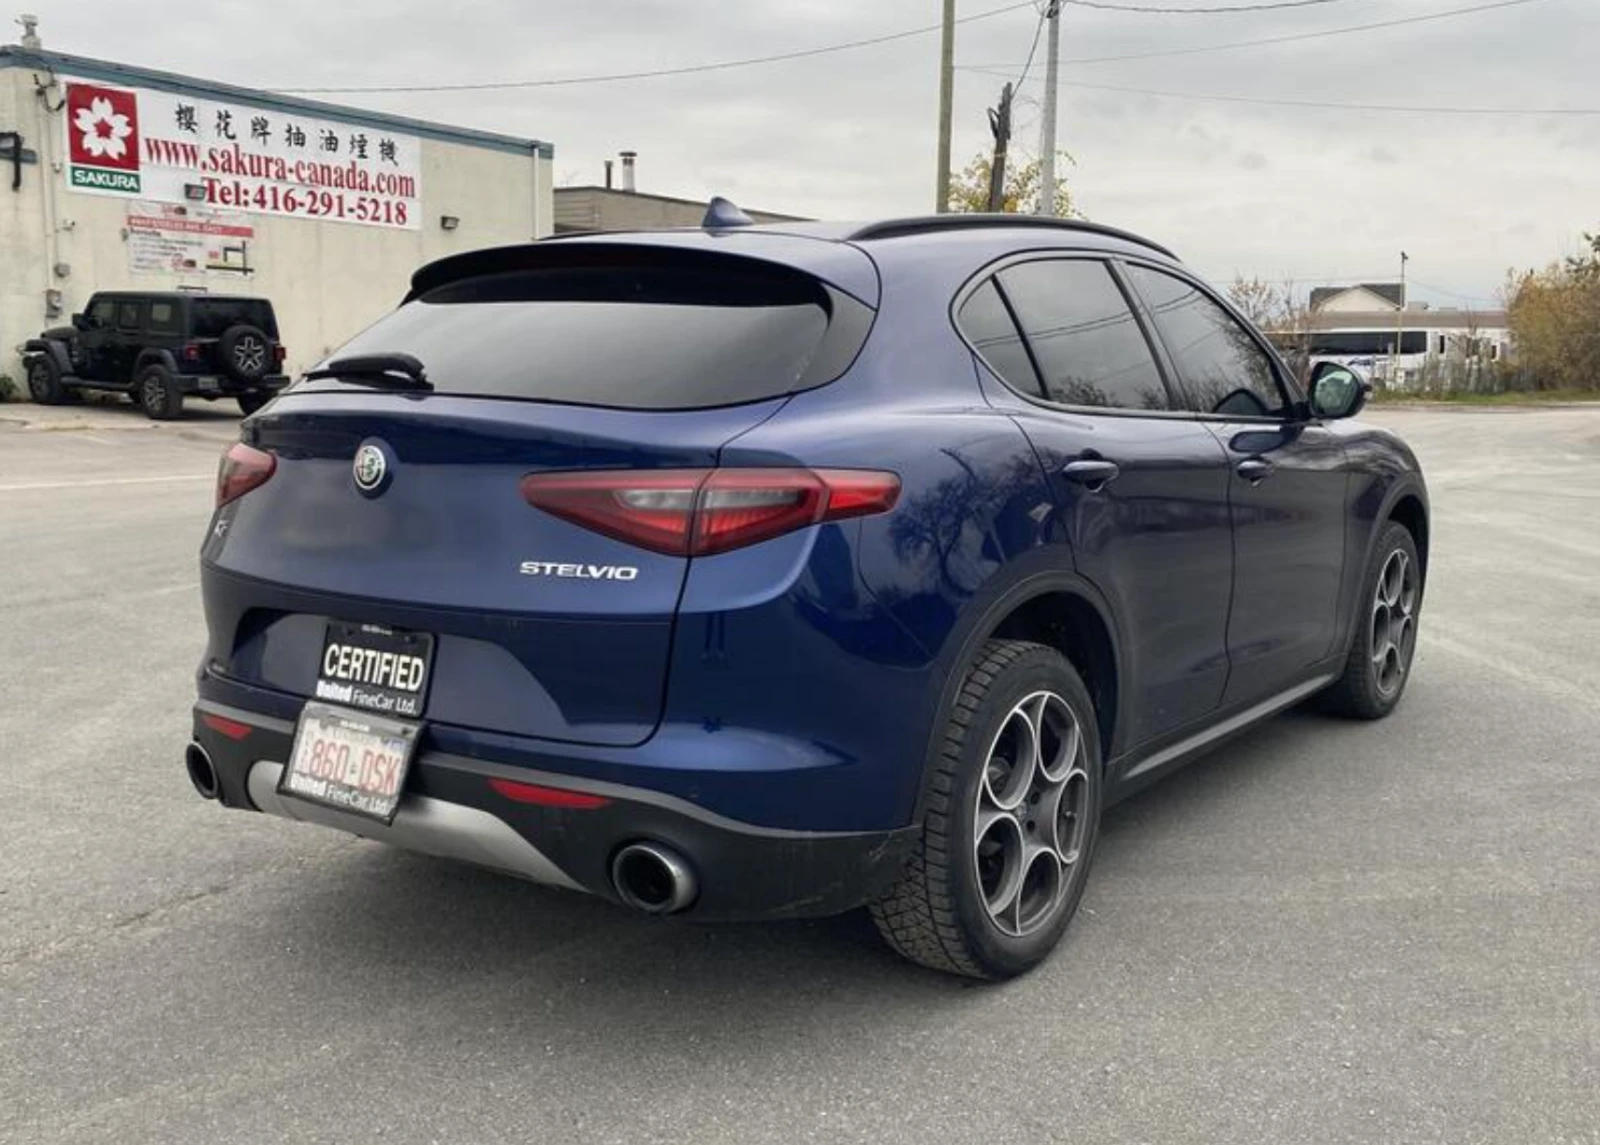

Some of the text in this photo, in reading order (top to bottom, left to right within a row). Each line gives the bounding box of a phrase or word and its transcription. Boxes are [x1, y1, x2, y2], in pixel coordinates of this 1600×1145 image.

[73, 170, 139, 190] SAKURA
[145, 138, 415, 198] www.sakura-canada.com
[520, 561, 638, 580] STELVIO
[324, 643, 425, 692] CERTIFIED
